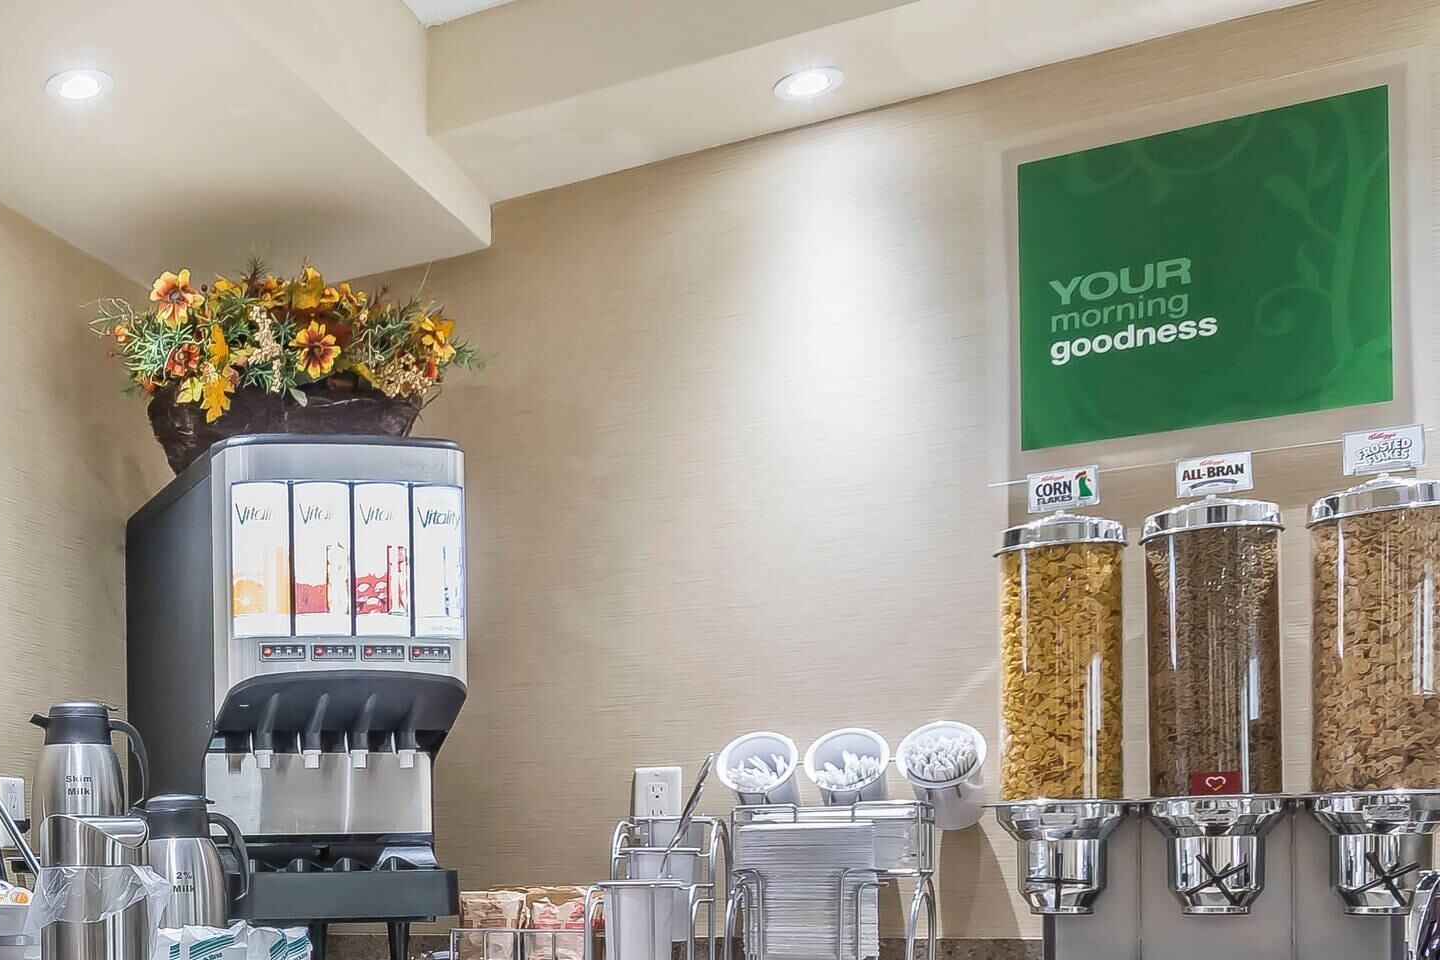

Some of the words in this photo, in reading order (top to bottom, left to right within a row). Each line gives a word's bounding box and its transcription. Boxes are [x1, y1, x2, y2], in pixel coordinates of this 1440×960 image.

[1049, 257, 1192, 305] YOUR
[1051, 293, 1189, 333] morning
[1050, 316, 1219, 366] goodness
[1355, 437, 1413, 461] FROSTED
[1366, 448, 1410, 465] FLAKES
[1182, 463, 1244, 481] ALL-BRAN
[1035, 480, 1072, 497] CORN
[1037, 494, 1073, 505] FLAKES
[417, 506, 460, 530] Vitality
[65, 775, 92, 783] Skim
[67, 787, 91, 795] Milk
[176, 871, 192, 880] 2%
[172, 885, 195, 893] Milk
